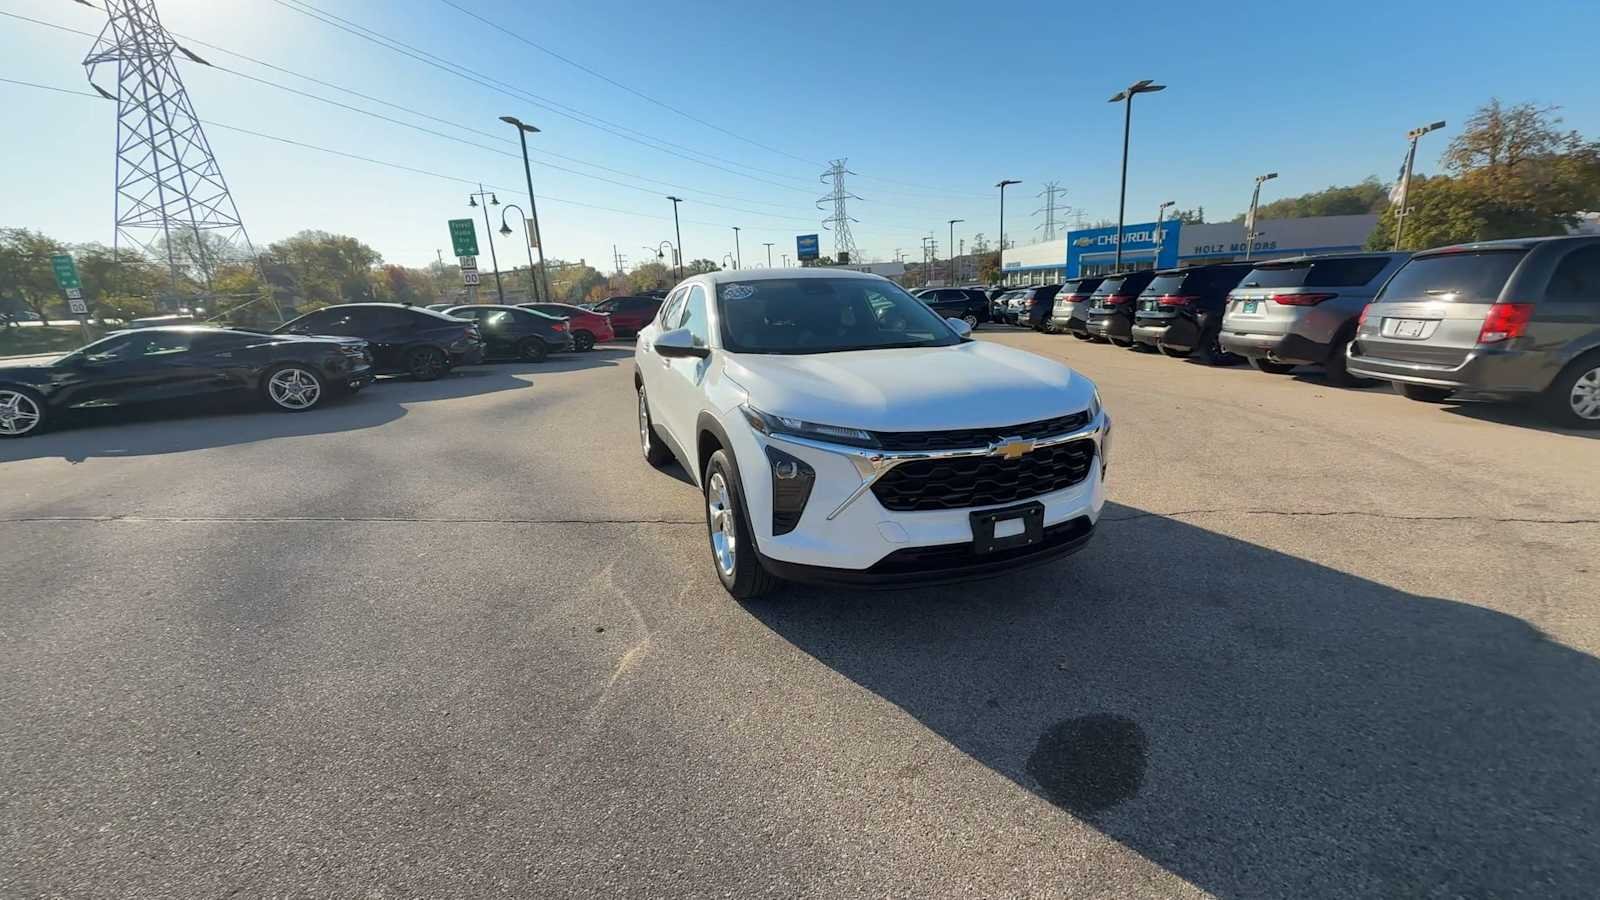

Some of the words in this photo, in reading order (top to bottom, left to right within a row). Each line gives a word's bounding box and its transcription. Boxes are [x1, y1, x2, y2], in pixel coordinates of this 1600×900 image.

[1097, 229, 1168, 246] CHEVROLT
[1195, 244, 1225, 254] HOLZ
[1230, 241, 1277, 252] MOORS
